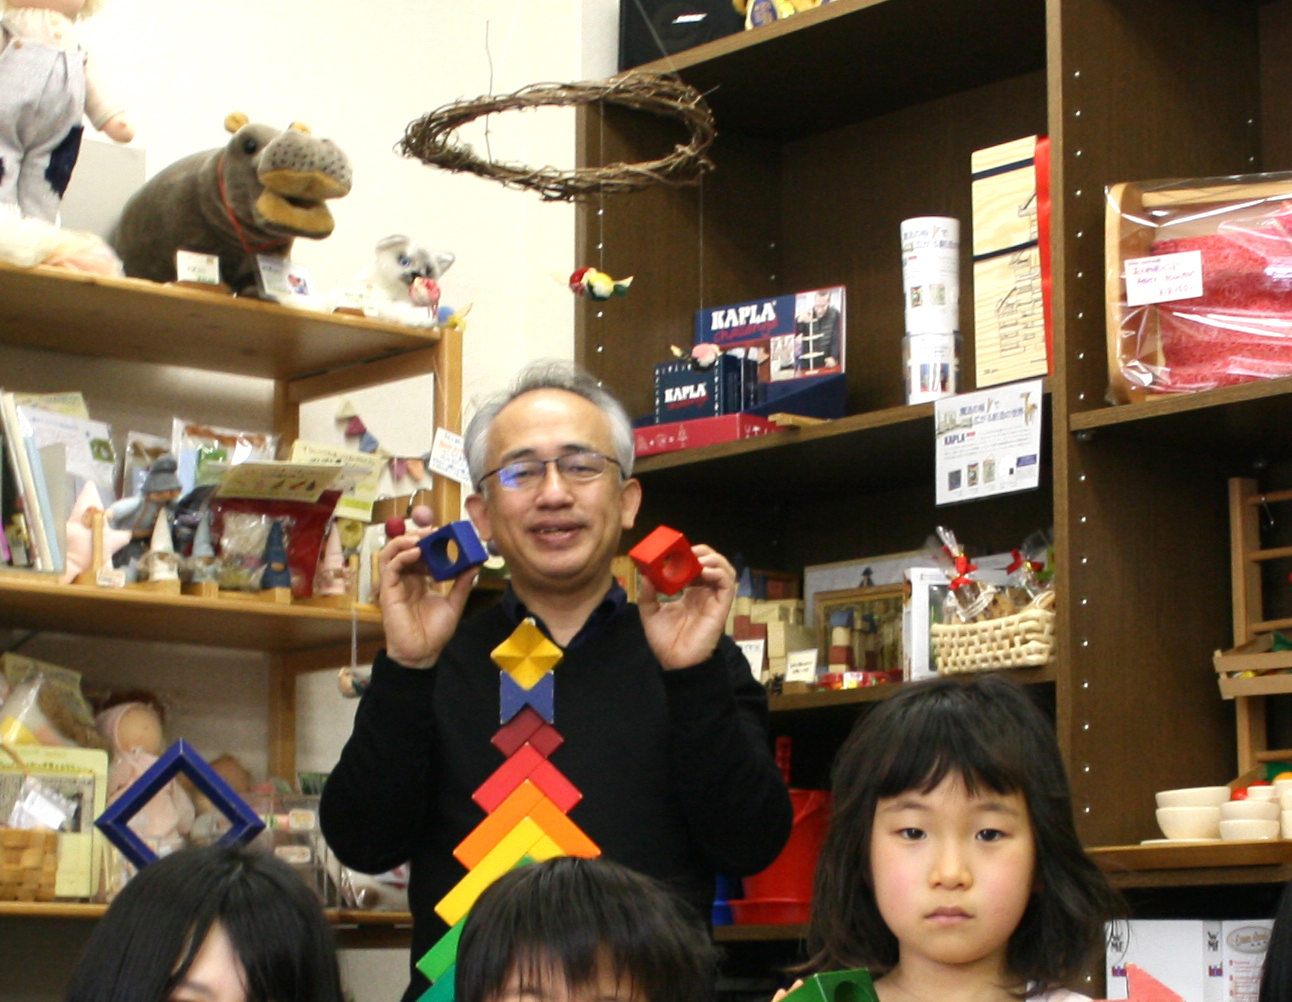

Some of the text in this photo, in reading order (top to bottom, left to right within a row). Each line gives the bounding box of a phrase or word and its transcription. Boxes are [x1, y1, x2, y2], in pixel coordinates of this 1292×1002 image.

[711, 302, 776, 331] KAPLA
[664, 384, 707, 403] KAPLA
[944, 433, 965, 446] KAPLA
